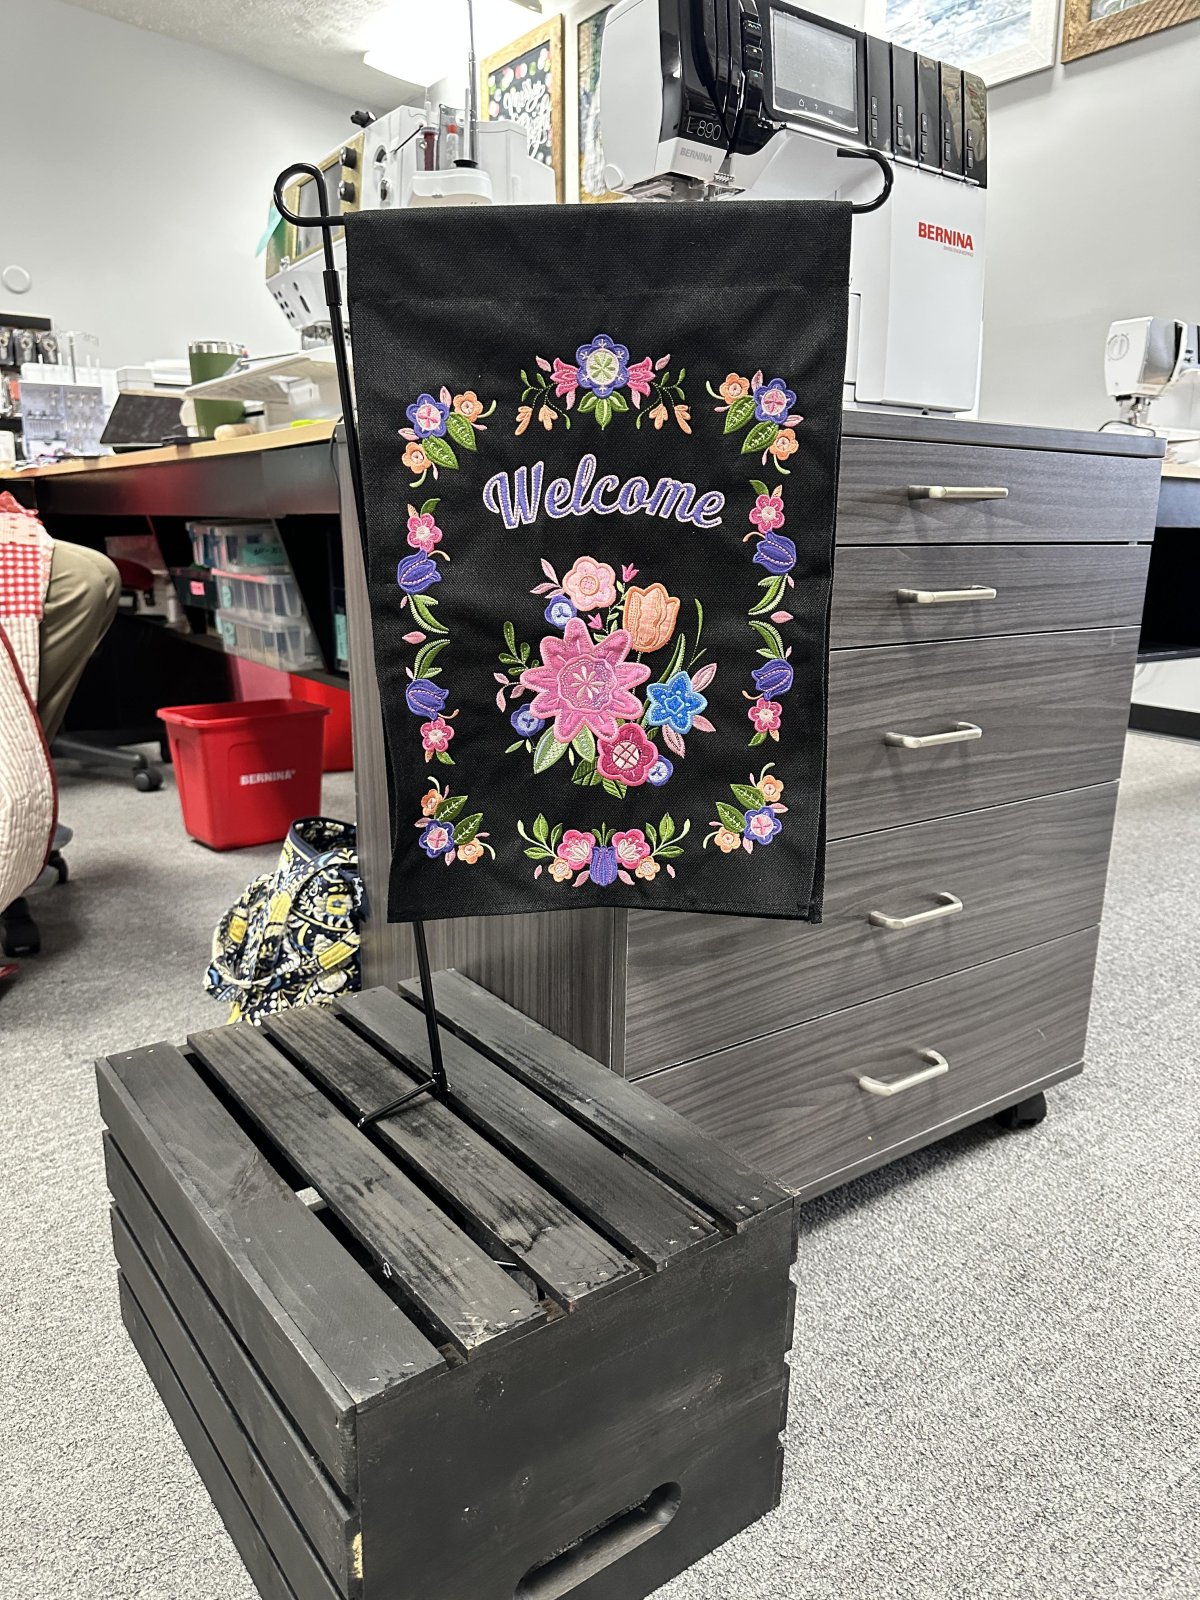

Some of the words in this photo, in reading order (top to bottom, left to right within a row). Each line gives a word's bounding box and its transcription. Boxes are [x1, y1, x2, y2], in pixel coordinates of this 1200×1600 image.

[697, 120, 722, 141] 890
[680, 147, 713, 164] BERNINA
[918, 221, 974, 251] BERNINA
[482, 453, 726, 529] Welcome
